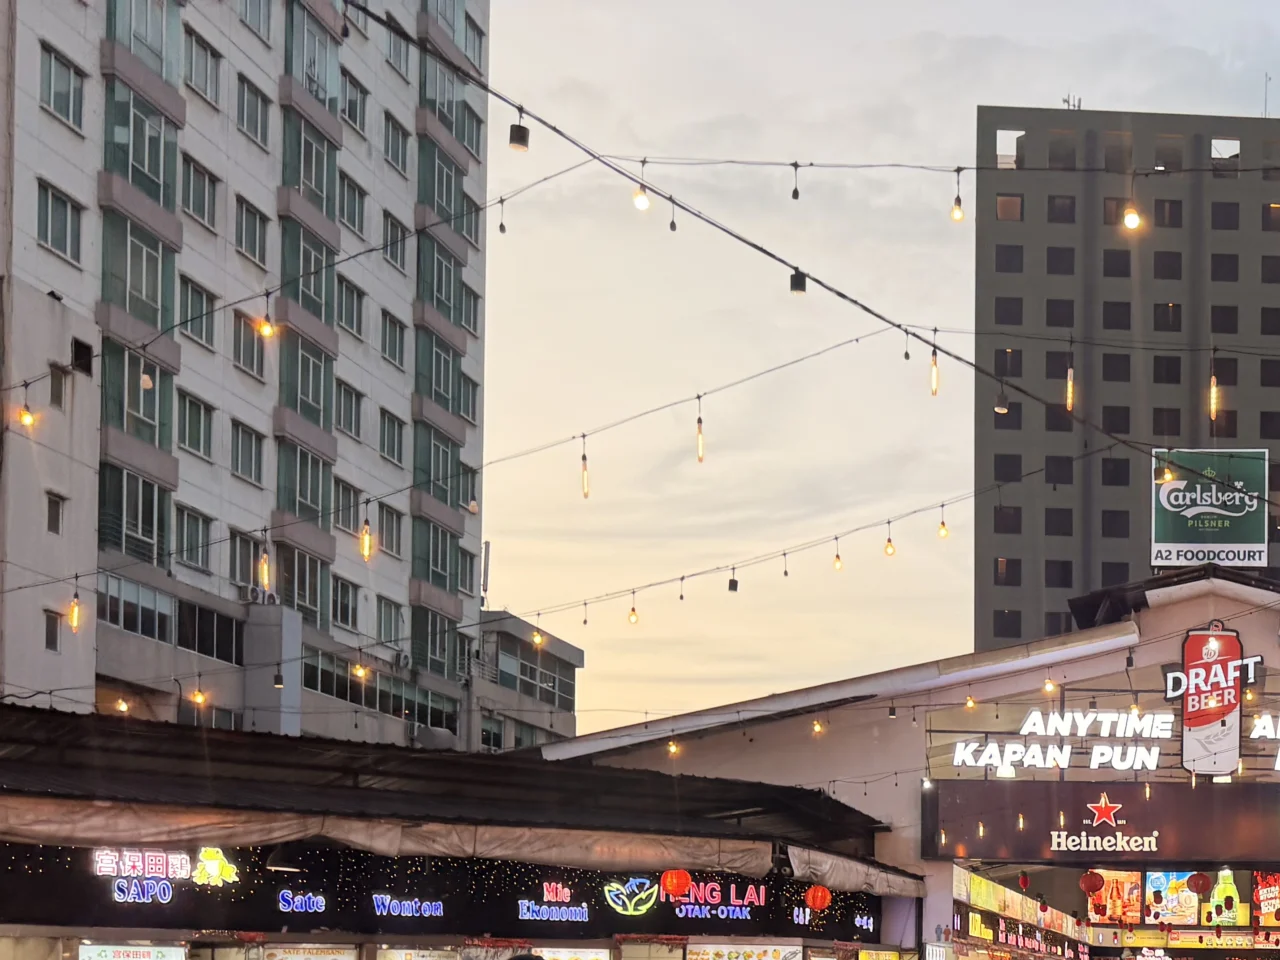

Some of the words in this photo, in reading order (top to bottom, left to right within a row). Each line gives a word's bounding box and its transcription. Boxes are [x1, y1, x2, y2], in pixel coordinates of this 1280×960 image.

[1158, 481, 1259, 518] Carlsberg
[1188, 520, 1230, 528] PILSNER
[1154, 550, 1173, 561] A2
[1176, 550, 1265, 562] FOODCOURT
[1166, 656, 1262, 698] DRAFT
[1187, 689, 1237, 712] BEER
[1020, 709, 1175, 738] ANYTIME
[953, 742, 1072, 769] KAPAN
[1090, 746, 1160, 770] PUN
[1050, 830, 1158, 852] Heineken
[114, 879, 173, 903] SAPO
[279, 889, 326, 912] Sate
[543, 882, 572, 902] Mie
[730, 883, 766, 906] LAI
[372, 894, 444, 917] Wonton
[518, 900, 590, 922] Ekonomi
